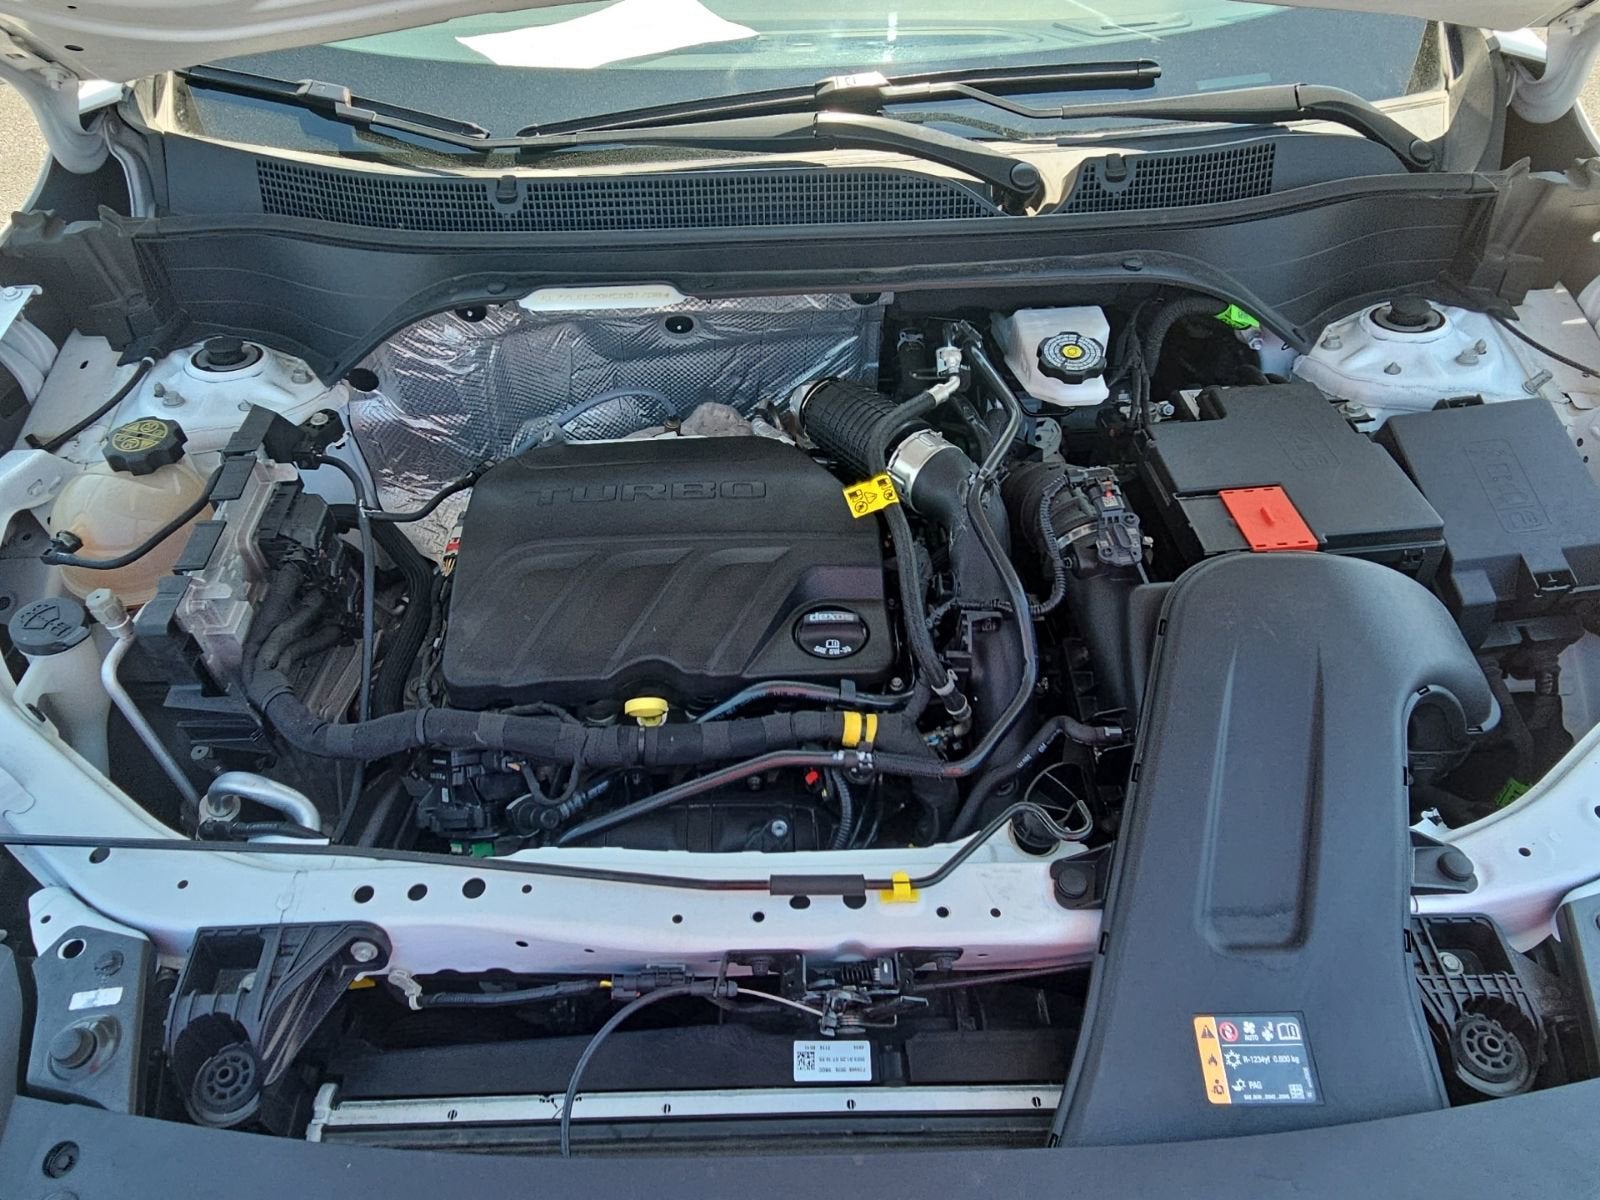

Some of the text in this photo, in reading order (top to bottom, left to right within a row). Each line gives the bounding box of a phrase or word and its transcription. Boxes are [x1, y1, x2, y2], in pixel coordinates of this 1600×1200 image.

[524, 481, 767, 507] TURBO
[809, 612, 854, 622] dexos
[1248, 1081, 1262, 1090] PAG
